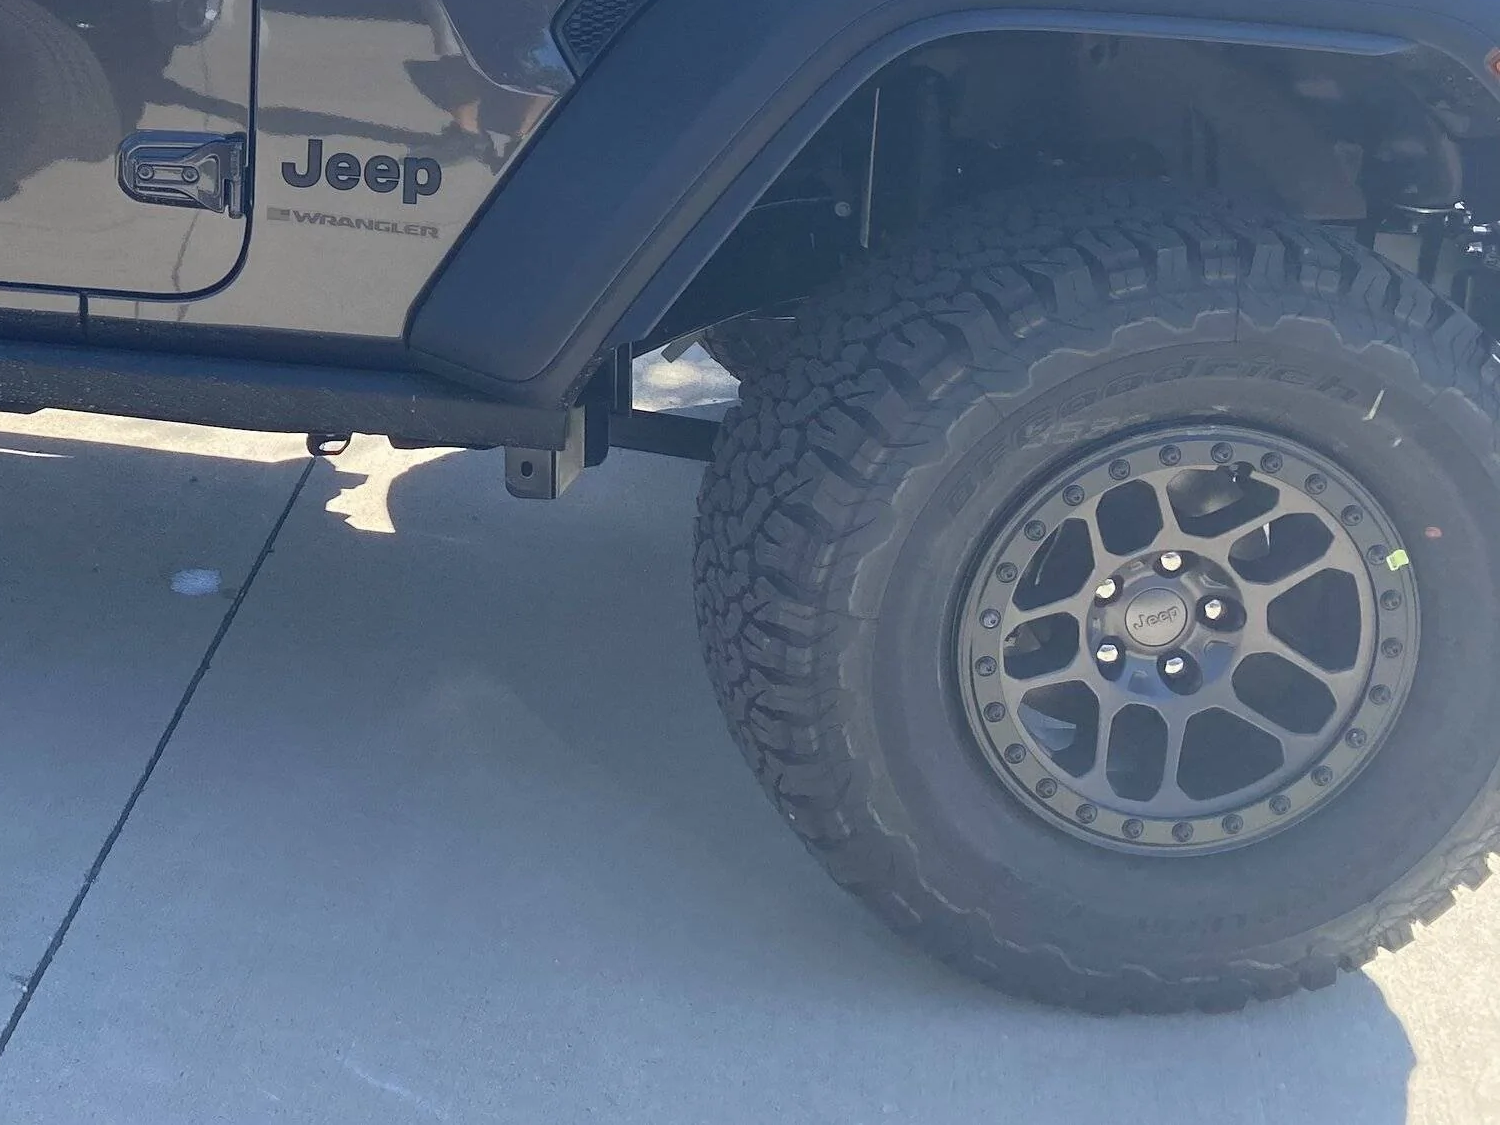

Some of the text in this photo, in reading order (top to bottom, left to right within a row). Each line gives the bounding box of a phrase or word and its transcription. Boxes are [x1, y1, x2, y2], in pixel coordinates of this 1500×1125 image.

[281, 139, 442, 205] Jeep
[292, 210, 441, 239] WRANGLER
[1133, 605, 1180, 630] Jeep
